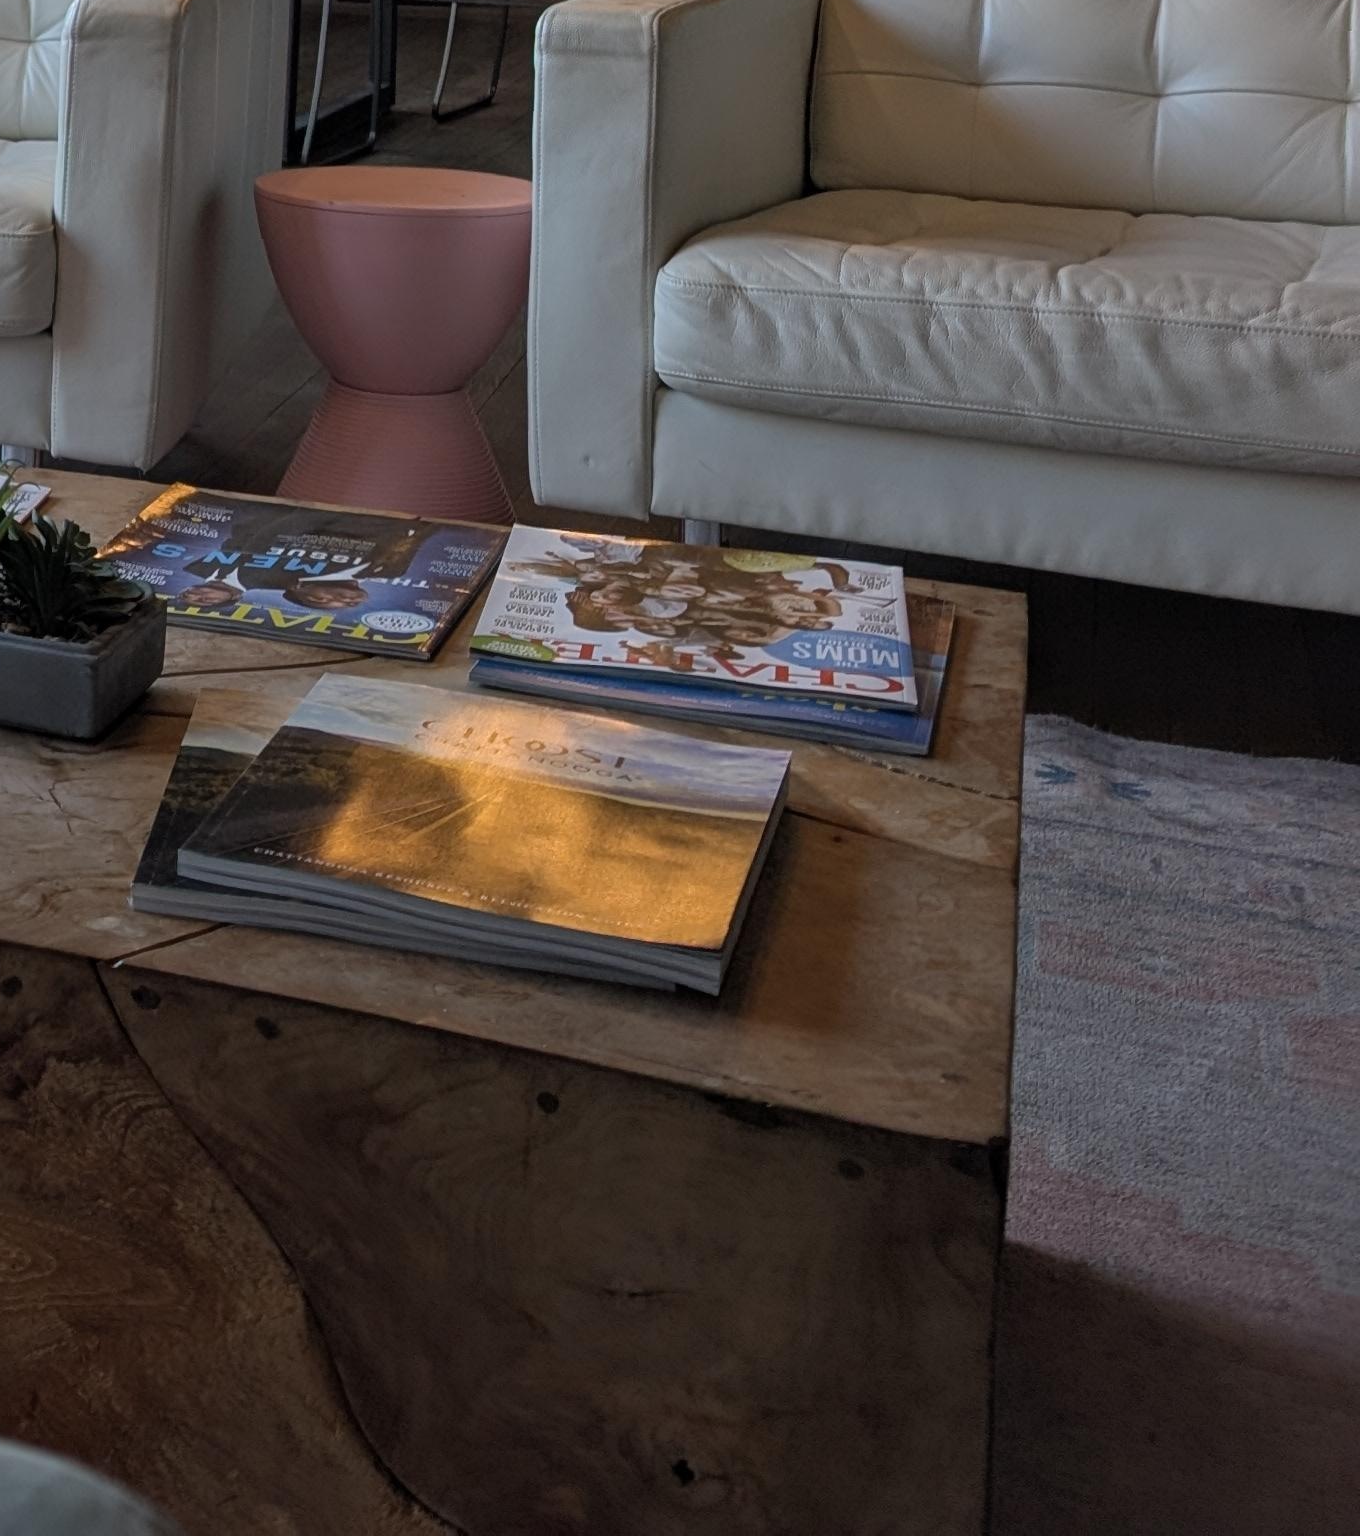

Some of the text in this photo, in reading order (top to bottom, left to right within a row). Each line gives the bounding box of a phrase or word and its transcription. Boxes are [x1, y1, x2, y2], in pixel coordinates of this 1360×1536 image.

[152, 542, 326, 576] MEN'S
[266, 545, 362, 565] ISSUE
[792, 641, 899, 668] MOMS
